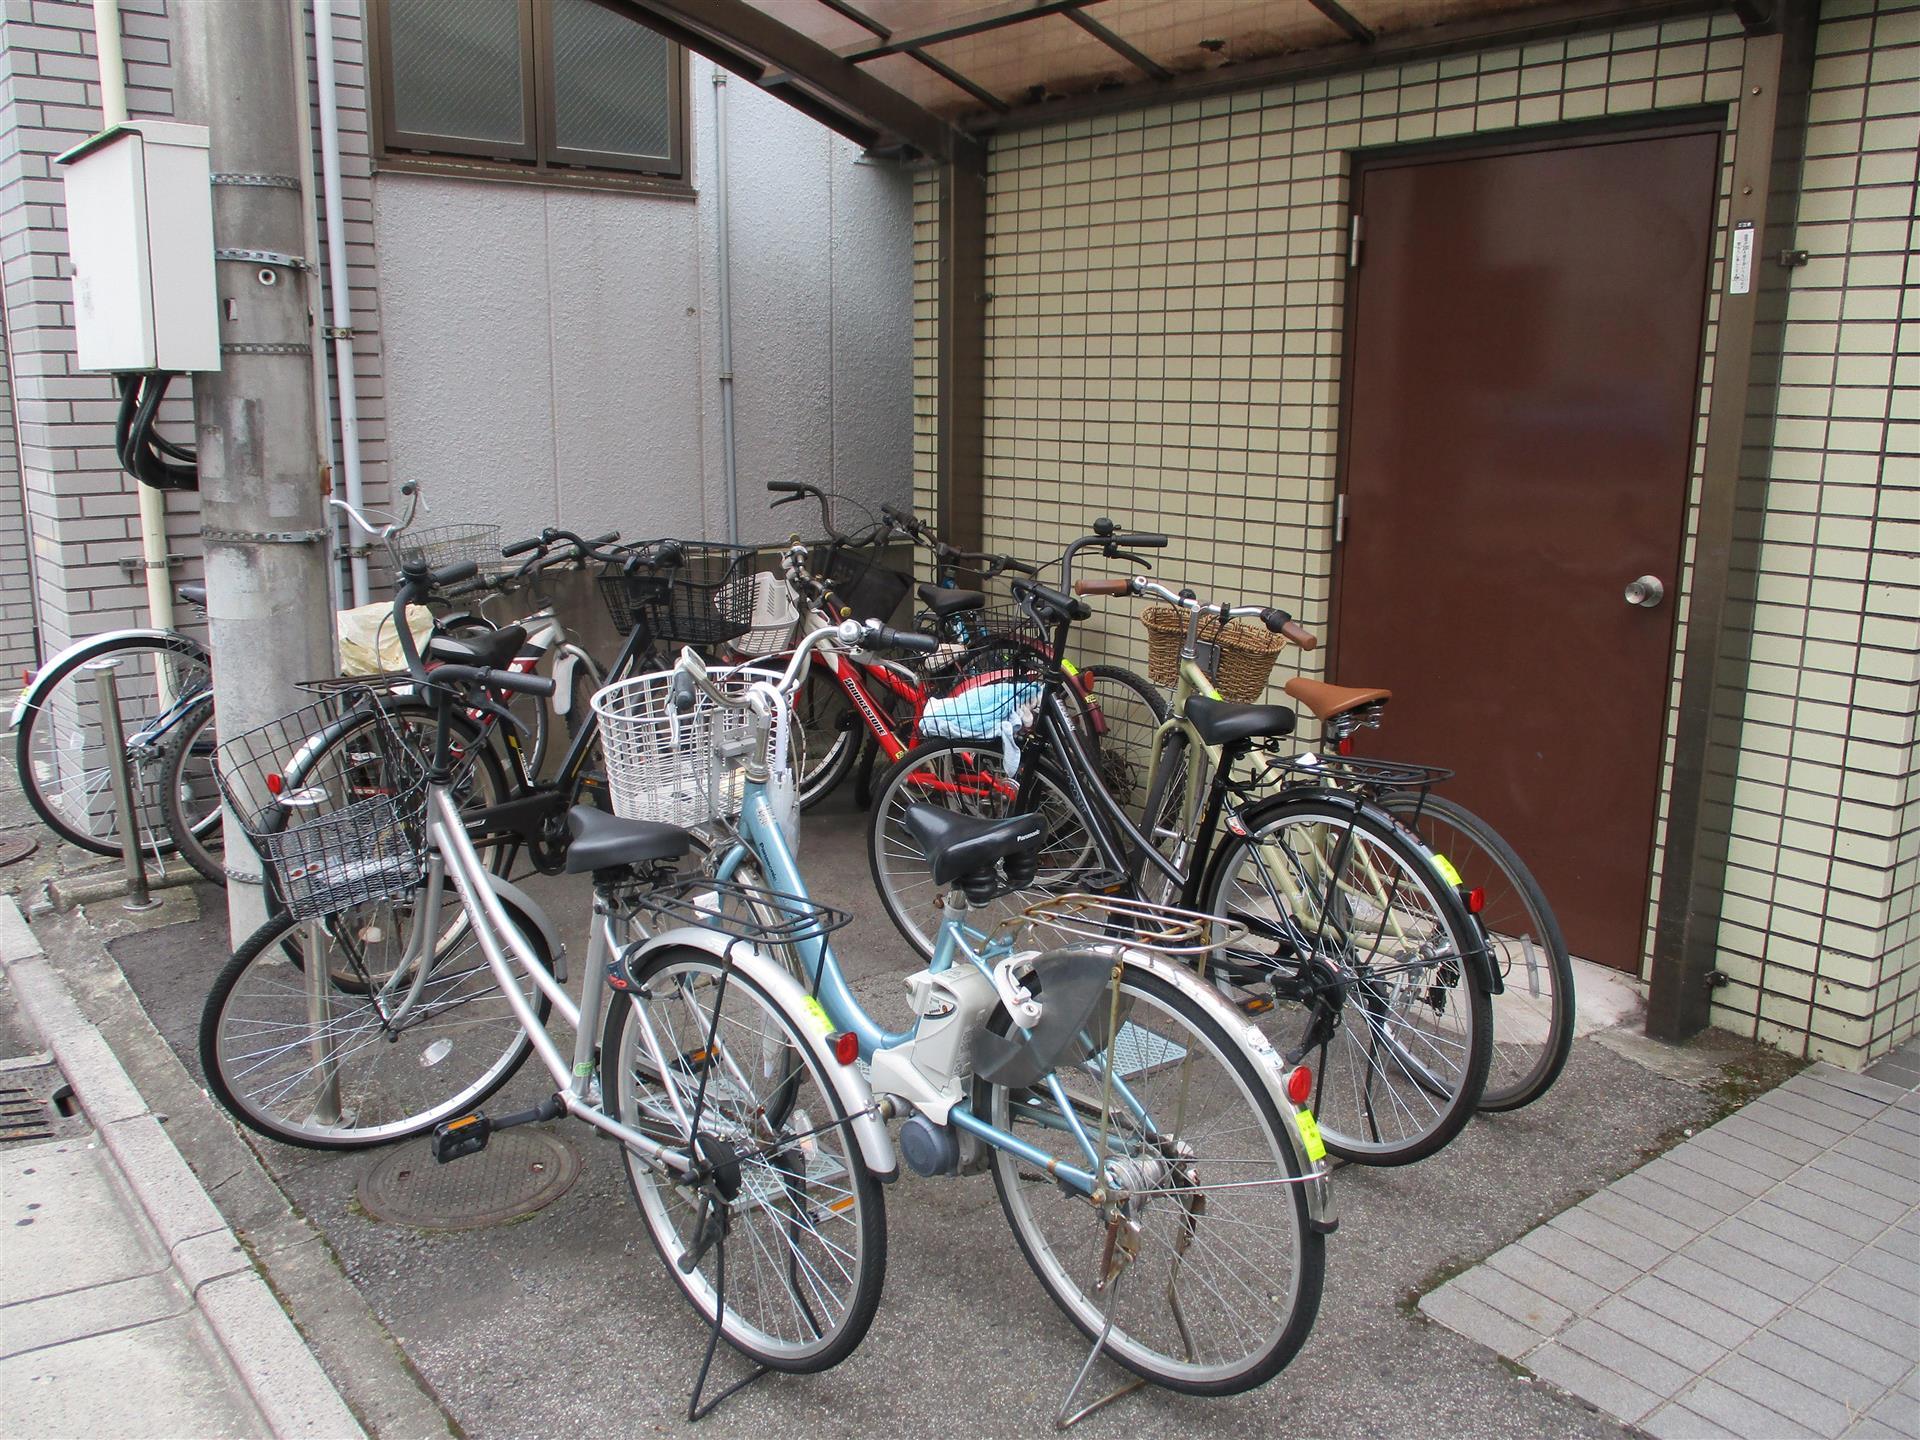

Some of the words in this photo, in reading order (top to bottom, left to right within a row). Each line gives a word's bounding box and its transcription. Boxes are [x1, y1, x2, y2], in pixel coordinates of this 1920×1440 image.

[843, 677, 887, 736] BRIDGESTONE
[1017, 829, 1040, 842] Panasonic
[760, 842, 776, 881] Panasonic
